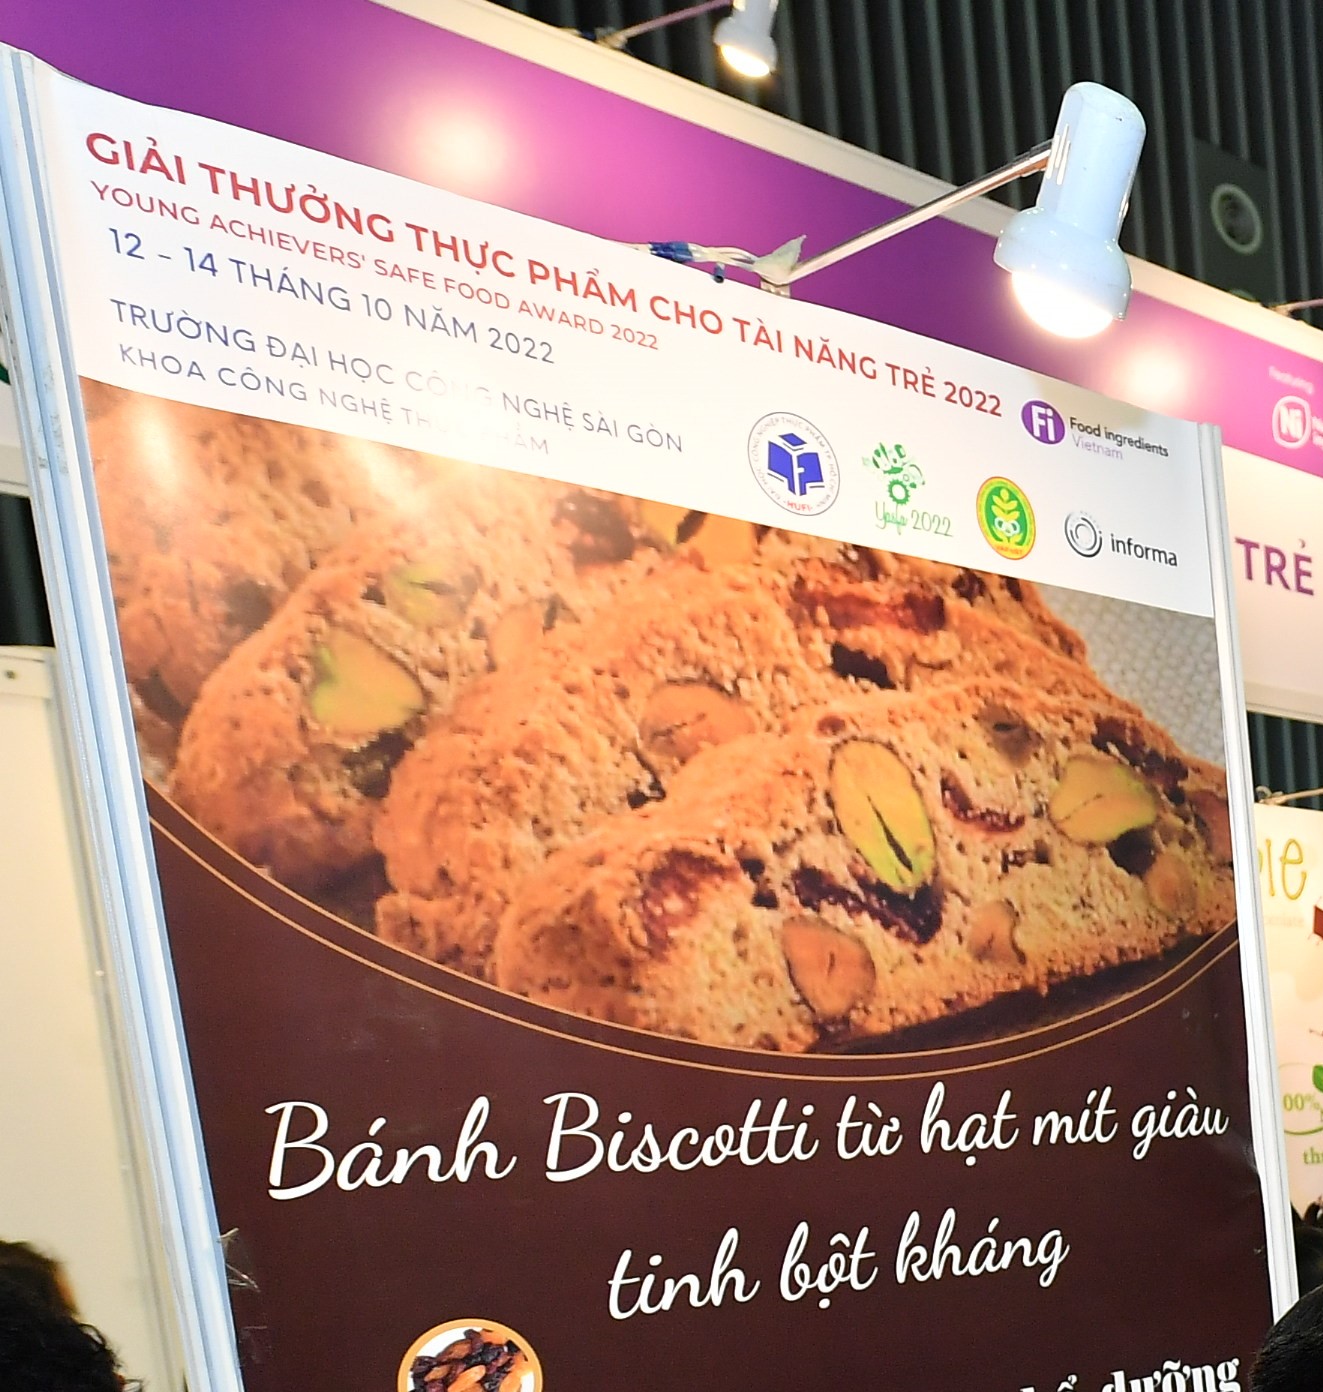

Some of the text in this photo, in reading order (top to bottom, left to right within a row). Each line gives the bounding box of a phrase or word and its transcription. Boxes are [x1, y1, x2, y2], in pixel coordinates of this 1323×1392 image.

[85, 130, 1002, 418] GIẢI THƯỞNG THỰC PHẨM CHO TÀI NĂNG TRẺ 2022
[90, 180, 659, 351] YOUNG ACHIEVERS' SAFE FOOD AWARD 2022
[108, 228, 145, 261] 12
[183, 247, 219, 278] 14
[229, 258, 352, 312] THÁNG
[362, 293, 392, 322] 10
[405, 303, 478, 344] NĂM
[487, 326, 556, 365] 2022
[111, 299, 257, 353] TRƯỜNG
[265, 334, 317, 370] ĐẠI
[329, 353, 395, 388] HỌC
[502, 391, 575, 432] NGHỆ
[583, 410, 618, 438] SÀI
[627, 423, 683, 453] GÒN
[119, 343, 394, 428] KHOA CÔNG NGHỆ
[1032, 404, 1055, 441] Fi
[1070, 417, 1169, 458] Food ingredients
[1072, 435, 1123, 461] Vietnam
[911, 511, 954, 538] 2022
[1110, 533, 1178, 568] informa
[1235, 537, 1314, 597] TRẺ
[264, 1081, 1229, 1200] Bánh Biscotti từ hạt mít giàu
[607, 1206, 1070, 1321] tinh bột kháng
